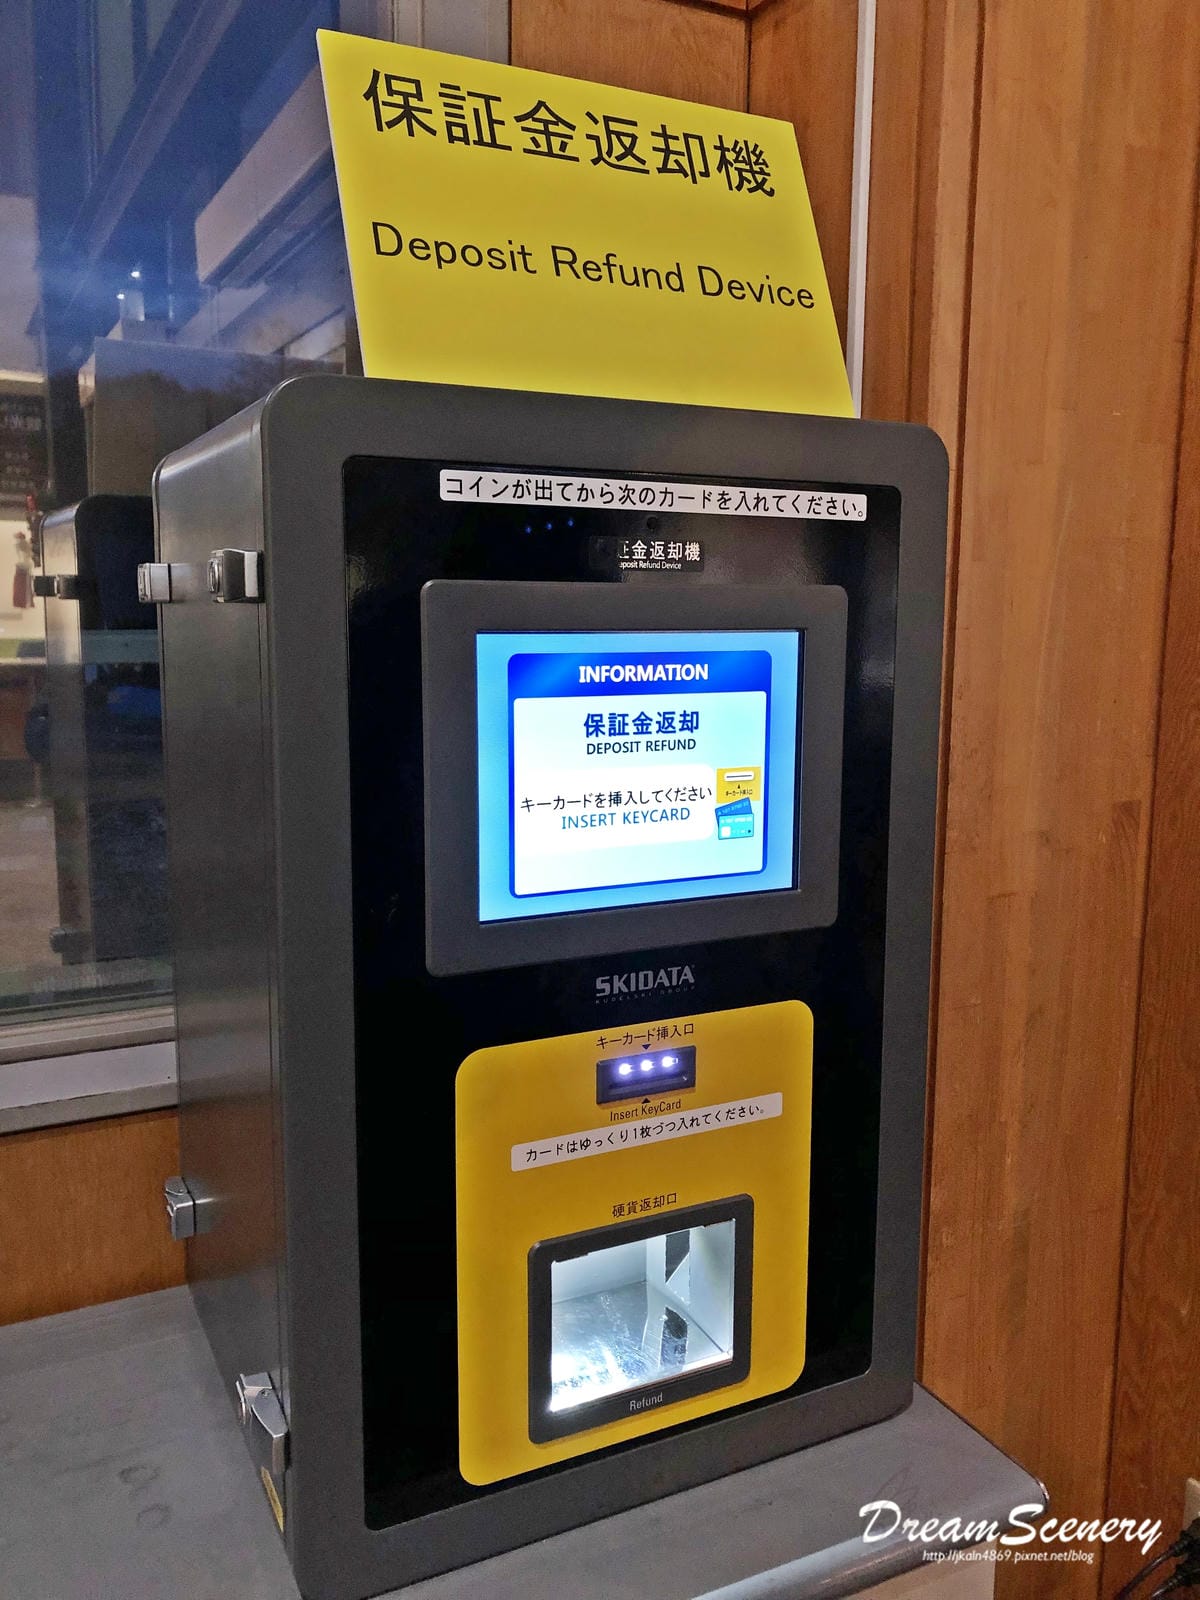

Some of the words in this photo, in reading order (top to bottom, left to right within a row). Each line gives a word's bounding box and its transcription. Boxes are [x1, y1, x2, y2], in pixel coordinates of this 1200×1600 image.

[363, 67, 776, 198] 保証金返却機
[371, 221, 538, 275] Deposit
[551, 244, 686, 294] Refund
[697, 264, 816, 309] Device
[445, 476, 866, 520] コインが出てから次のカードを入れてください。
[639, 560, 660, 570] Refund
[662, 561, 682, 570] Device
[578, 663, 709, 684] INFORMATION
[583, 710, 700, 739] 保証金返却
[586, 740, 641, 755] DEPOSIT
[645, 737, 697, 752] REFUND
[520, 785, 713, 813] キーカードを挿入してください
[561, 812, 616, 830] INSERT
[622, 806, 691, 825] KEYCARD
[595, 964, 695, 997] SKIDATA
[596, 1023, 695, 1050] キーカード挿入口
[610, 1108, 638, 1122] Insert
[641, 1098, 682, 1116] KeyCard
[525, 1104, 765, 1163] カードはゆっくり1枚づつ入れてください。
[611, 1192, 678, 1218] 硬貨返却口
[629, 1392, 663, 1411] Refund
